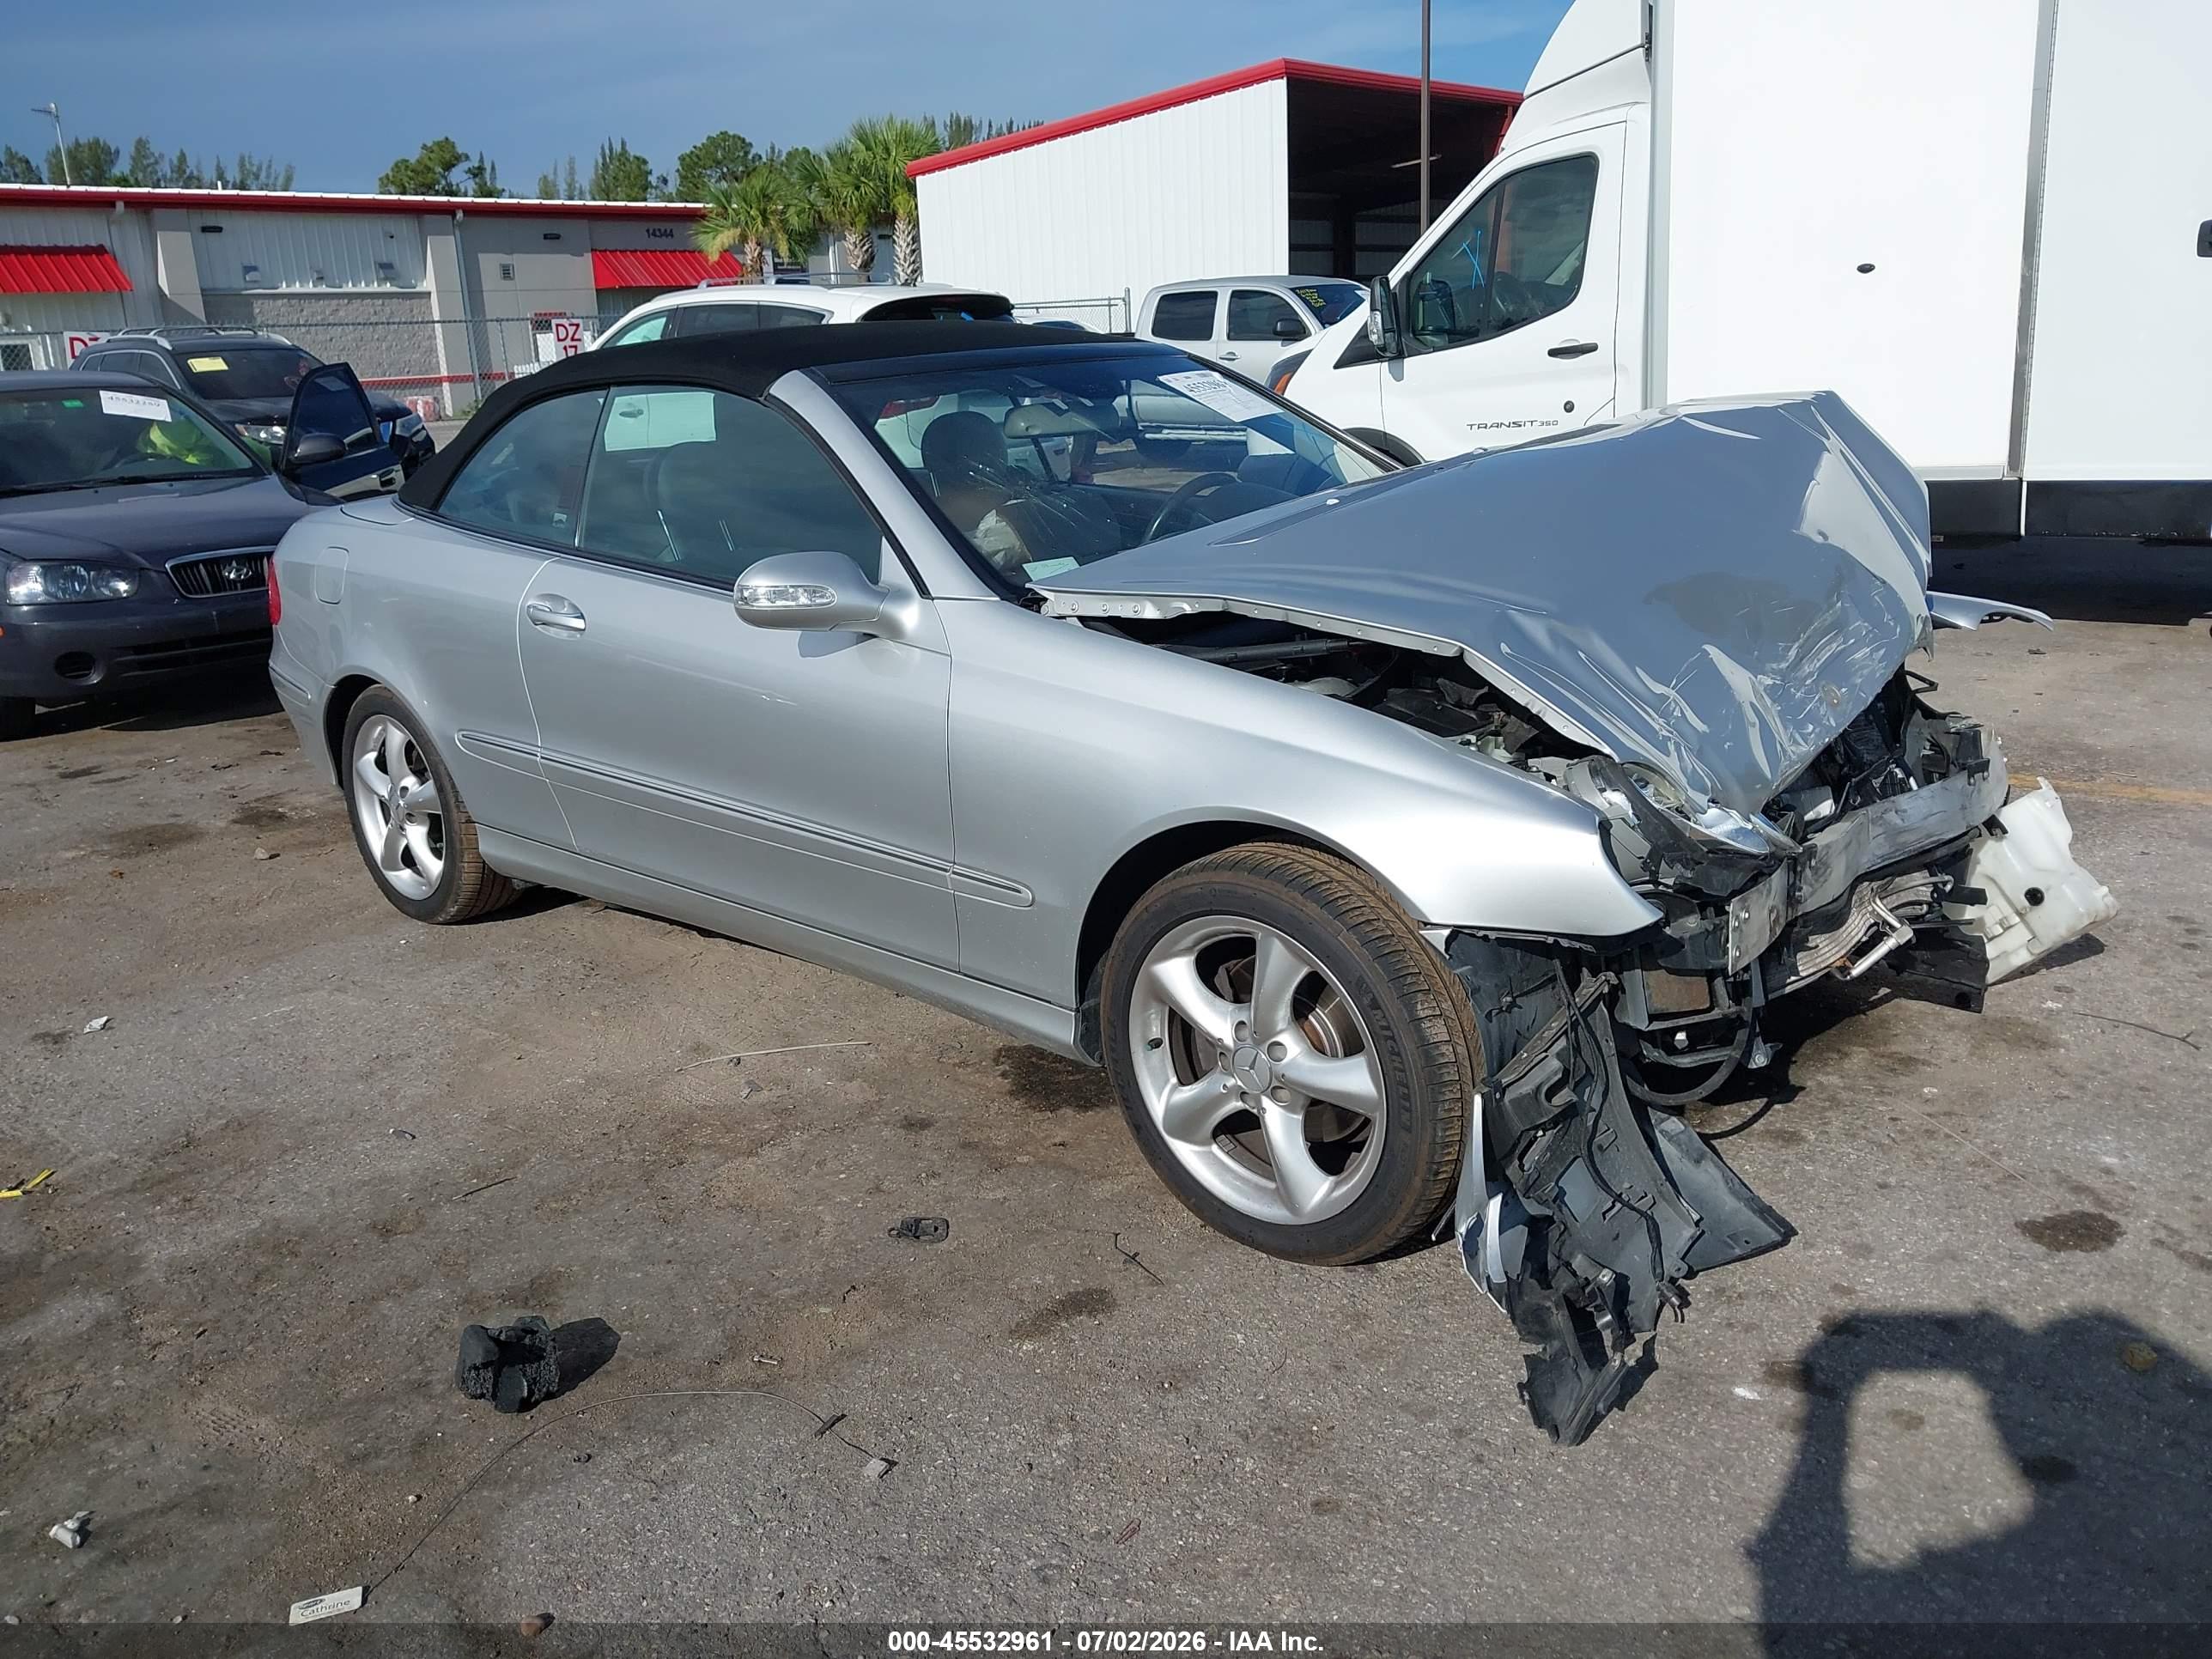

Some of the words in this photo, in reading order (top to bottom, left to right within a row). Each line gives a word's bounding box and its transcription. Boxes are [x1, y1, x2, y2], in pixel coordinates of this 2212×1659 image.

[645, 228, 674, 239] 14344
[555, 323, 582, 343] DZ
[1371, 1006, 1413, 1135] MICHELIN
[301, 1600, 350, 1617] Cathrine
